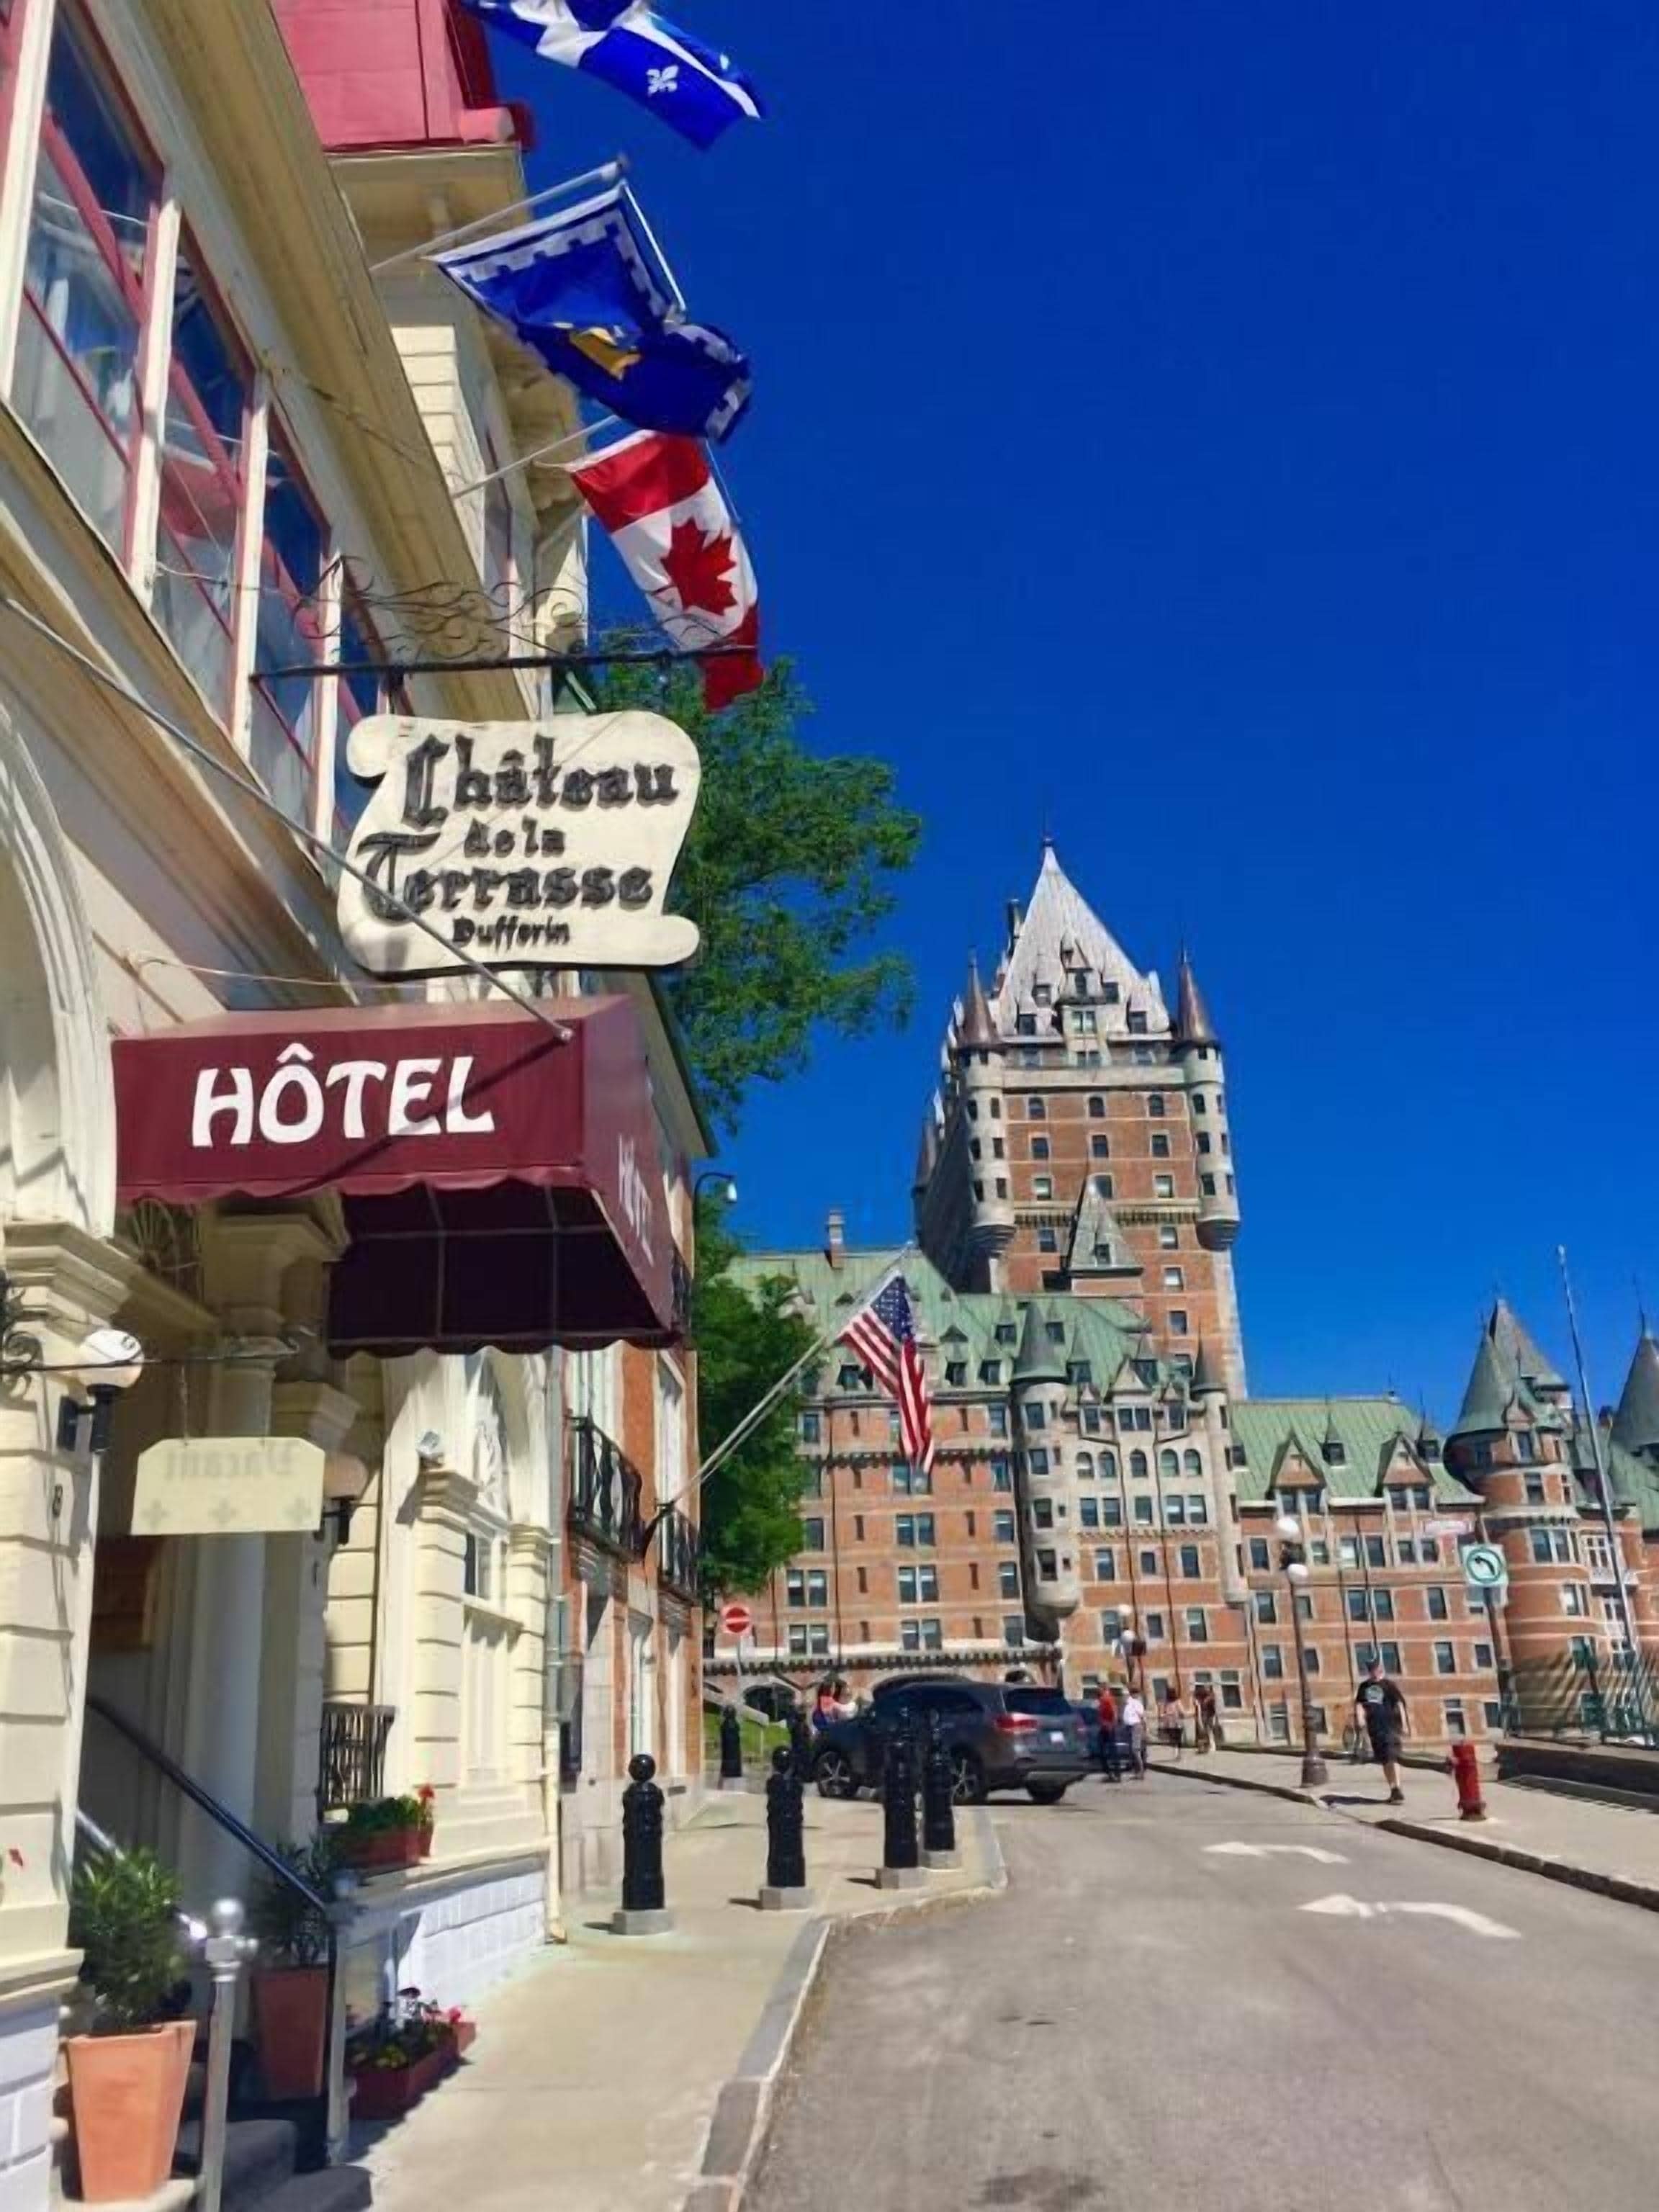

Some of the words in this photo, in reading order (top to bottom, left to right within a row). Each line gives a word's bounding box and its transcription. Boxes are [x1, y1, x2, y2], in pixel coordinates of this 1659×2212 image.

[402, 733, 680, 830] Château
[356, 831, 652, 927] Terrasse
[464, 817, 516, 858] de
[521, 815, 565, 858] la
[452, 914, 570, 953] Dufferin
[191, 1042, 495, 1148] HÔTEL
